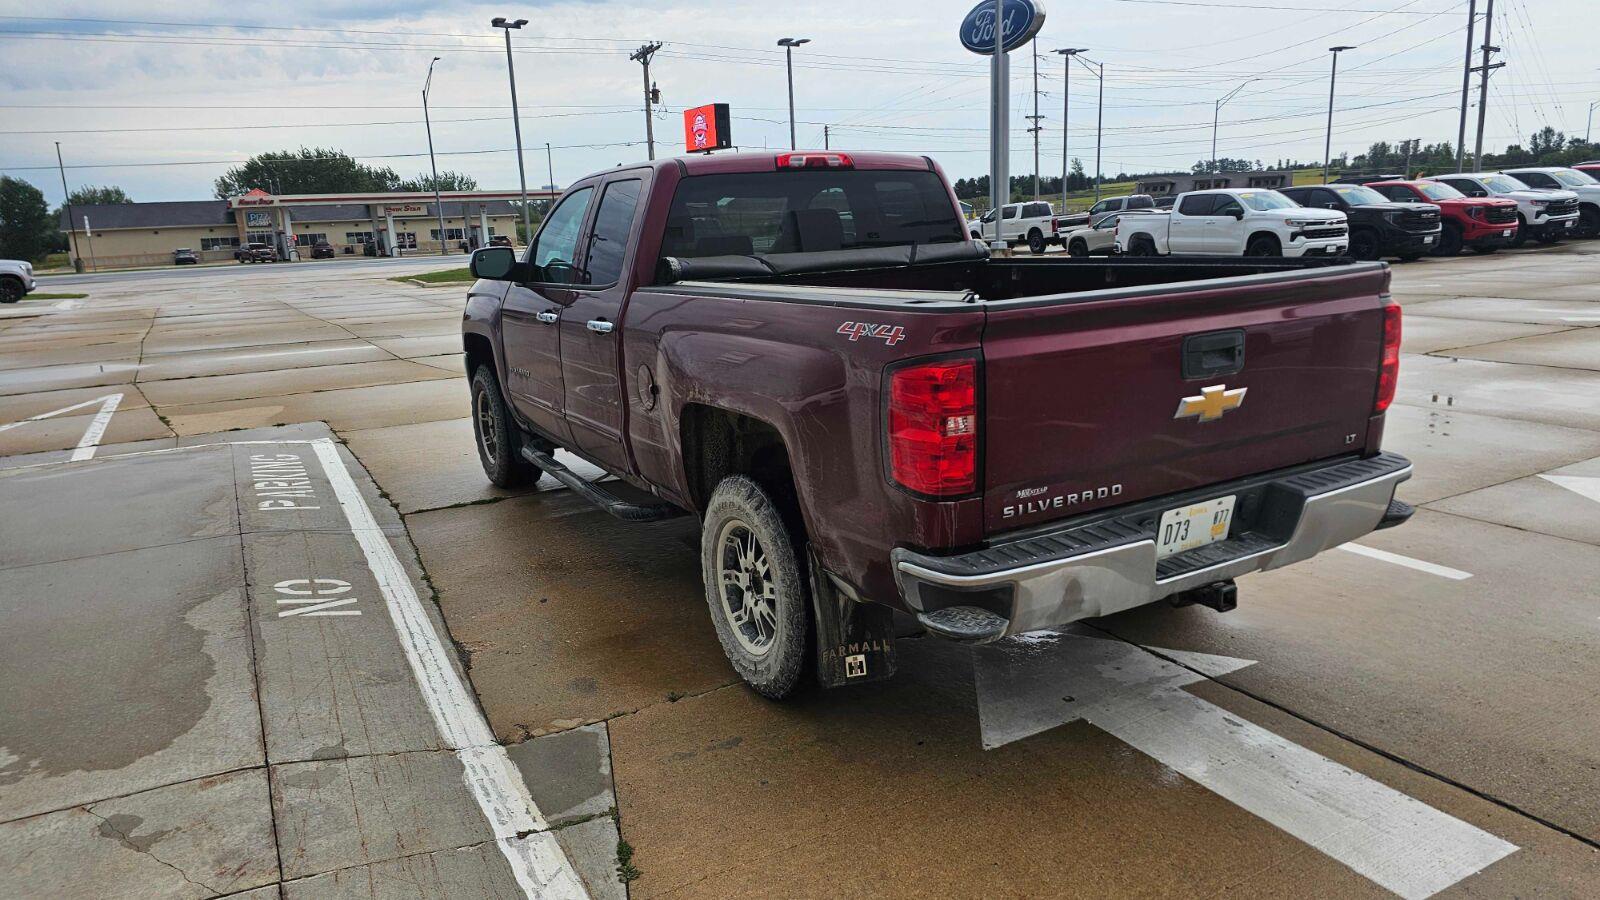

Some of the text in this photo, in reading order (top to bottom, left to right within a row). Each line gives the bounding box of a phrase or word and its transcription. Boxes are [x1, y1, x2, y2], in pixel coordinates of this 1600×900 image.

[1346, 433, 1357, 444] LT
[1003, 484, 1123, 519] SILVERADO
[250, 454, 362, 617] NO PARKING
[1163, 519, 1191, 546] D73
[822, 639, 890, 664] FARMALL
